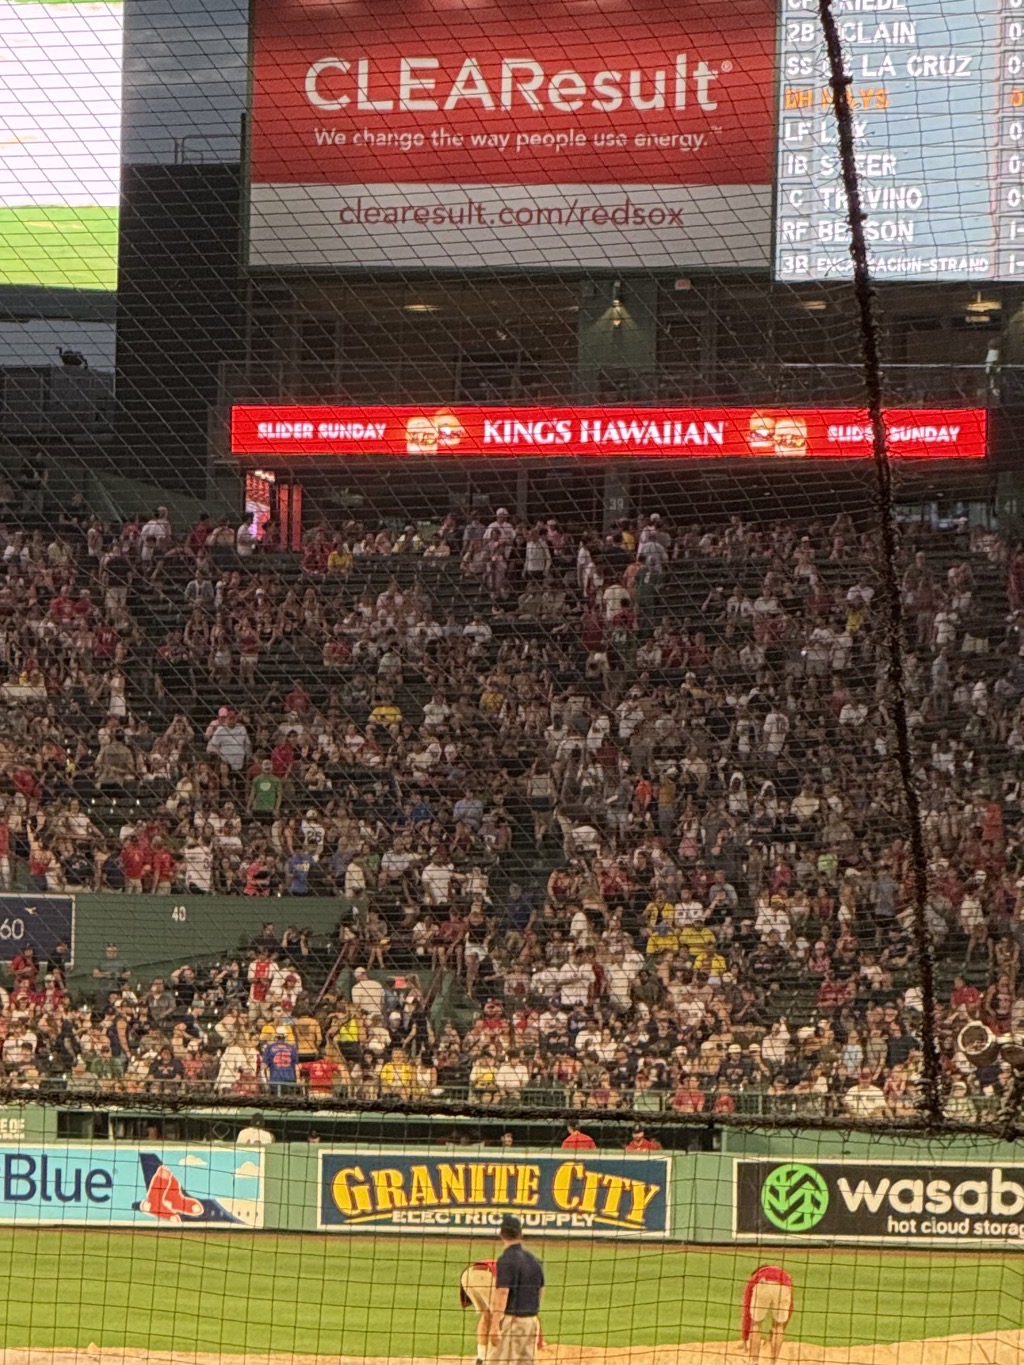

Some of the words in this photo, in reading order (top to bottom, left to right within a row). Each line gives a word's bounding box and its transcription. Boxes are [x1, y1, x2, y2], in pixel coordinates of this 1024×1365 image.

[786, 22, 815, 43] 2B
[837, 21, 916, 44] CLAIN
[1009, 22, 1024, 41] 0
[787, 56, 813, 76] SS
[861, 54, 897, 77] LA
[906, 54, 974, 78] CRUZ
[1008, 55, 1024, 75] 0
[784, 87, 813, 110] DH
[314, 128, 347, 146] We
[352, 127, 425, 151] change
[431, 128, 464, 147] the
[471, 132, 516, 152] way
[516, 129, 588, 153] people
[593, 133, 628, 148] use
[784, 121, 812, 142] LF
[820, 121, 868, 144] LX
[820, 154, 897, 176] SEER
[789, 188, 804, 208] C
[819, 186, 924, 210] TRVINO
[339, 197, 686, 227] clearesult.com/redsox
[782, 221, 809, 242] RF
[818, 219, 915, 243] BESON
[782, 255, 809, 274] 3B
[257, 422, 314, 440] SLIDER
[317, 422, 387, 440] SUNDAY
[482, 417, 573, 445] KING'S
[579, 419, 725, 446] HAWAIIAN
[827, 424, 875, 442] SLIDE
[887, 424, 961, 443] SUNDAY
[171, 905, 187, 922] 40
[331, 1162, 541, 1216] GRANITE
[553, 1161, 661, 1223] CITY
[836, 1168, 1024, 1216] wasab
[391, 1210, 504, 1225] ELECTRIC
[887, 1214, 917, 1234] hot
[920, 1216, 970, 1235] cloud
